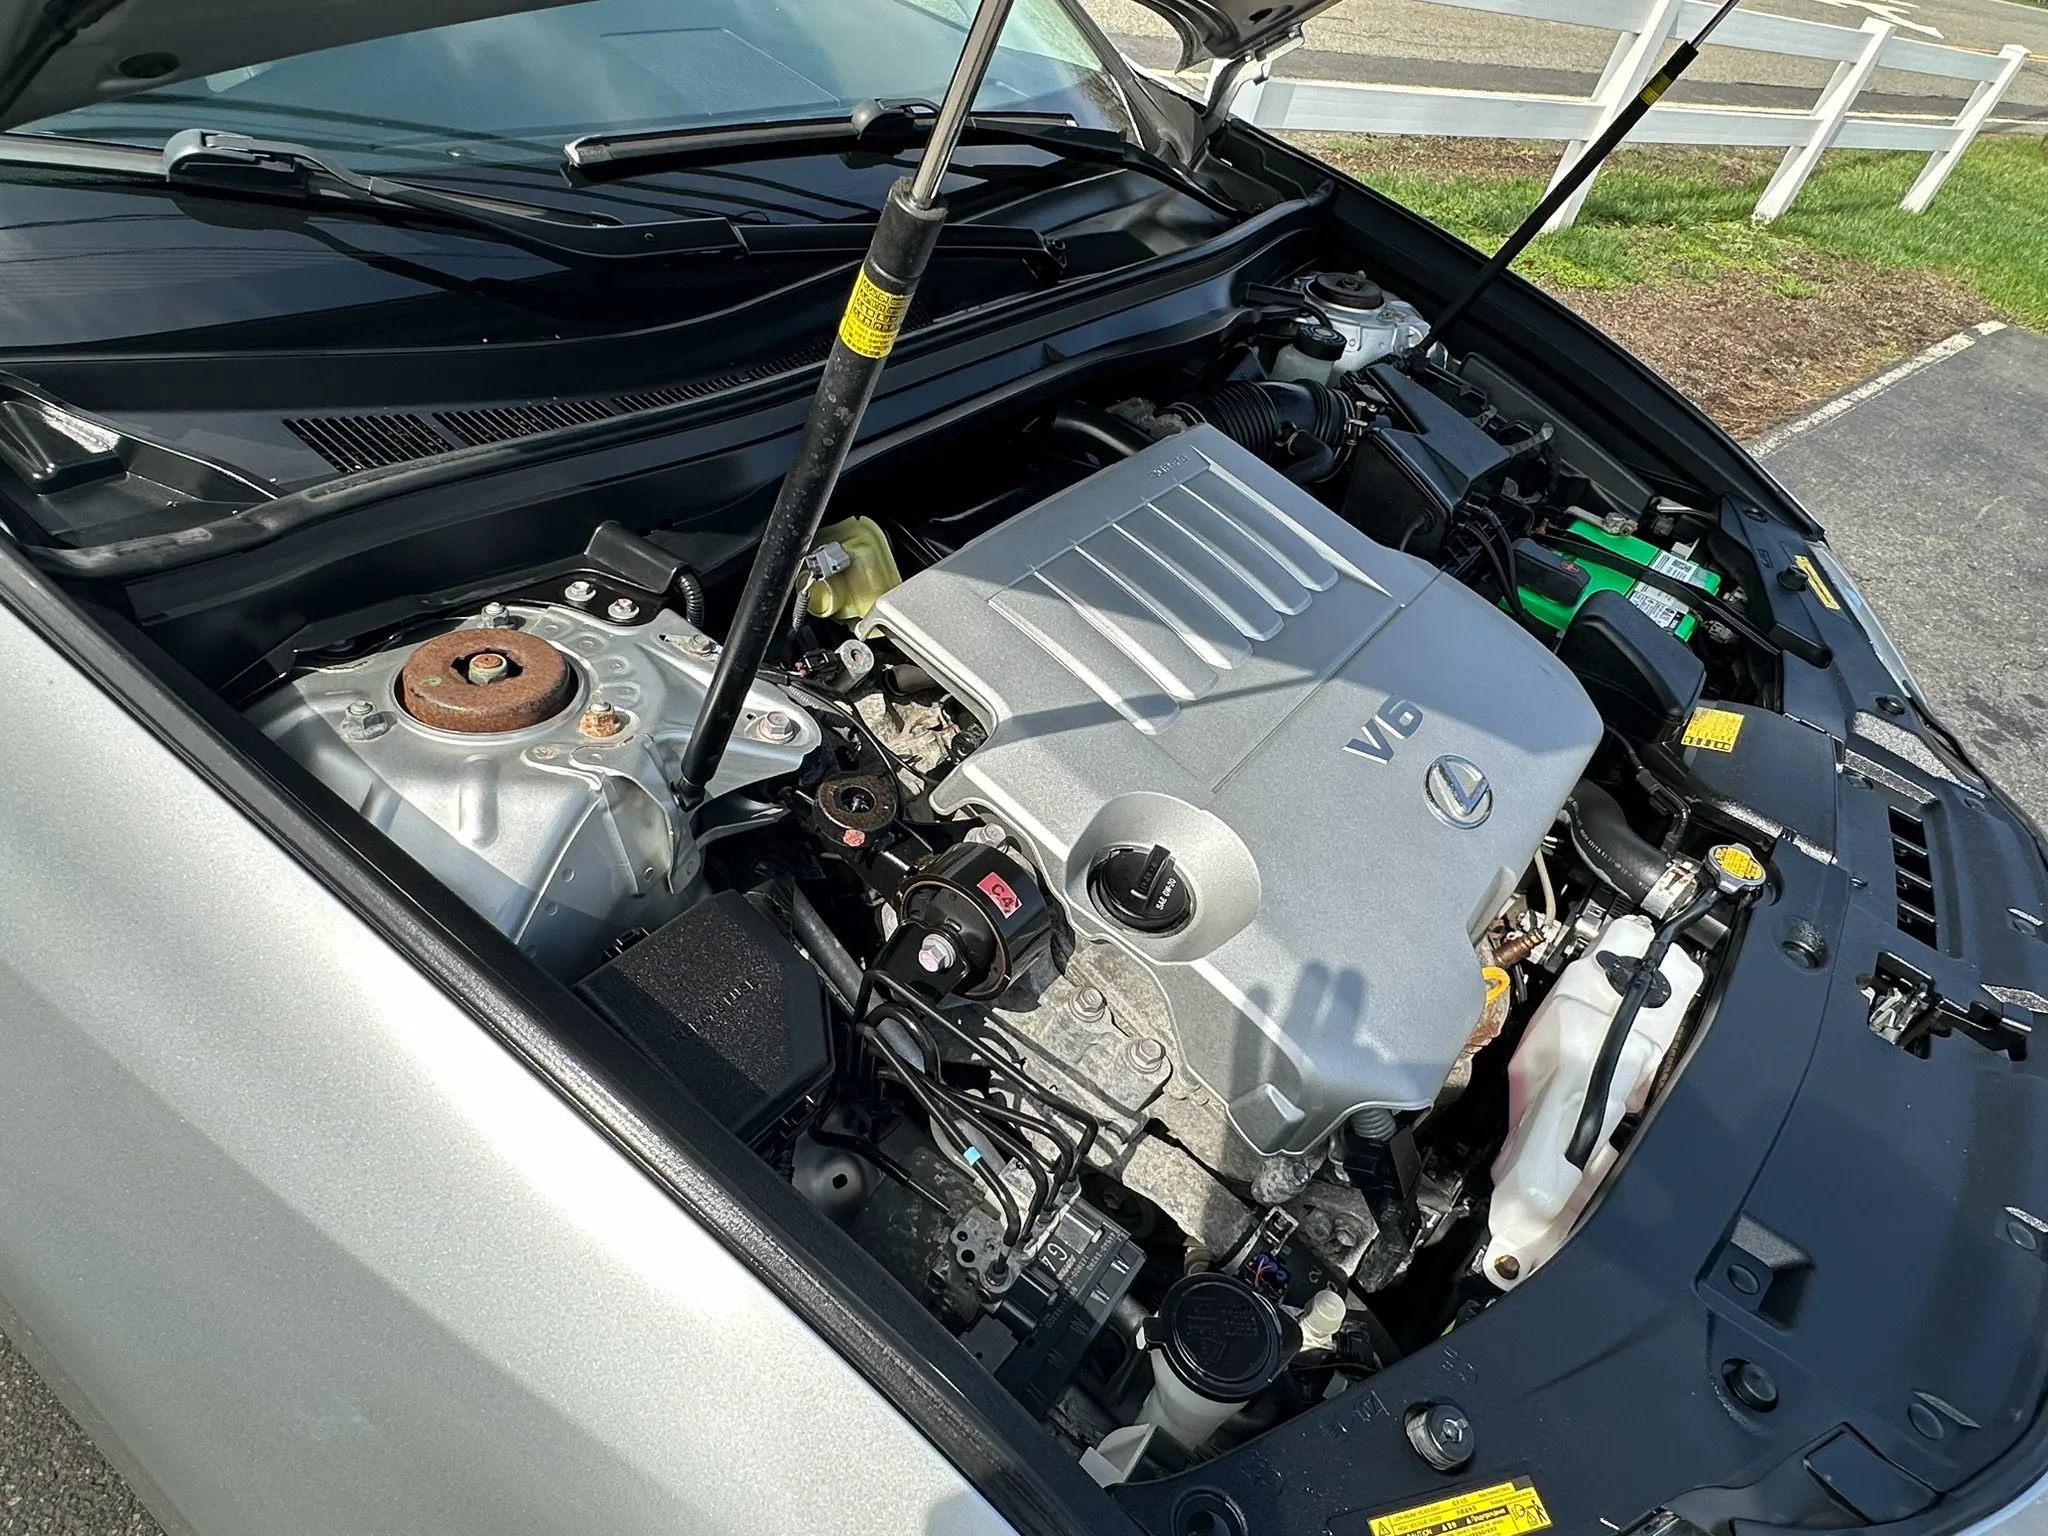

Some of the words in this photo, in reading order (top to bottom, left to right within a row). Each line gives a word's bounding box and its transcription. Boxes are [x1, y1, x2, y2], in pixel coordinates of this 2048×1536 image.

[1342, 693, 1424, 765] V6
[1155, 896, 1168, 911] SAE
[1162, 877, 1177, 897] 0W-20
